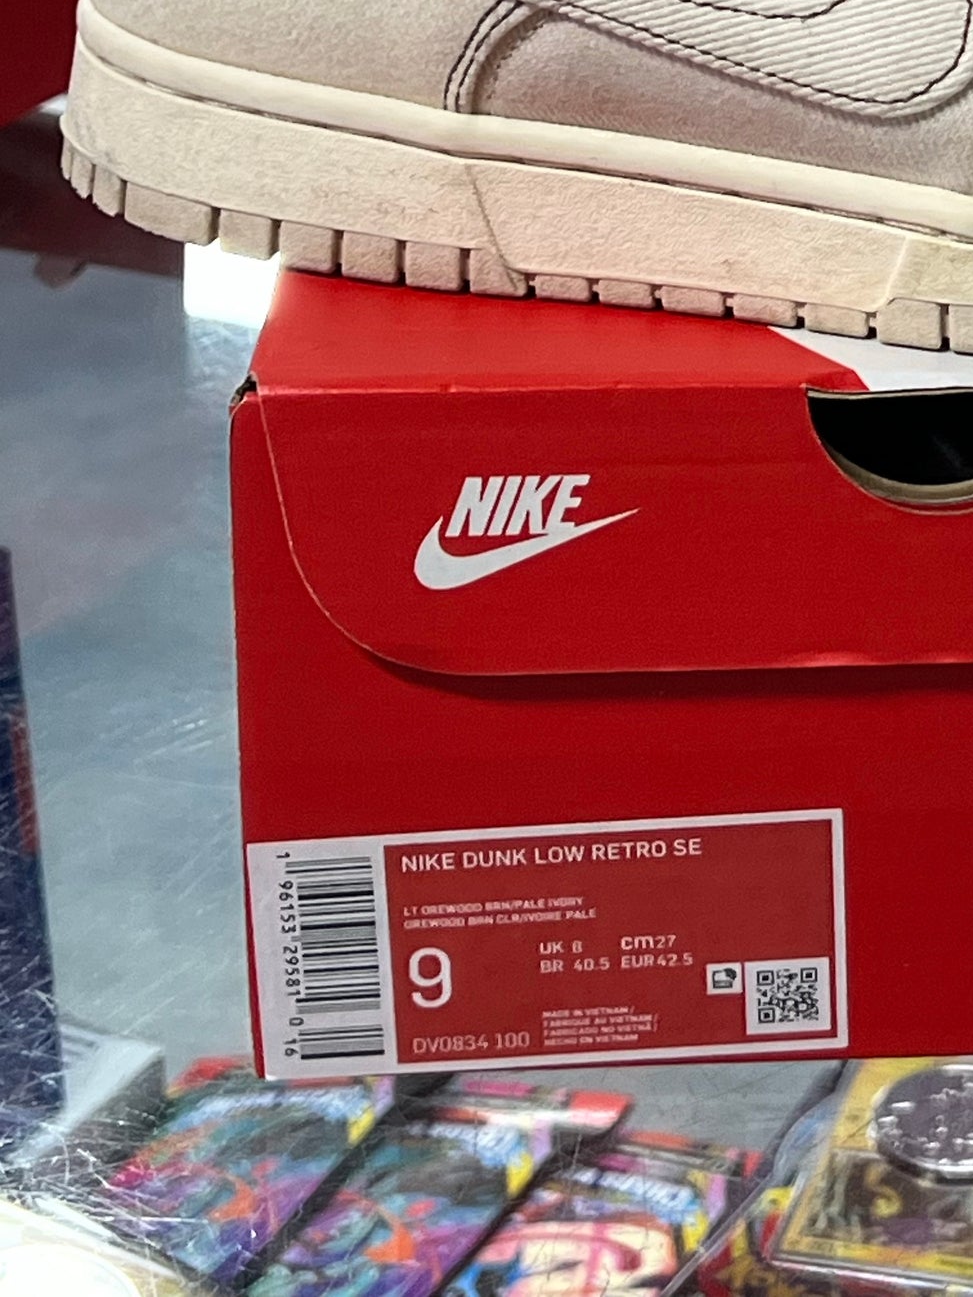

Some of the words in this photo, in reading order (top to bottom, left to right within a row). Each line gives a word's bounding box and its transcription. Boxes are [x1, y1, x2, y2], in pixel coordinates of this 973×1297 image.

[444, 473, 592, 539] NIKE
[401, 853, 455, 873] NIKE
[463, 848, 527, 870] DUNK
[534, 844, 586, 865] LOW
[591, 840, 666, 861] RETRO
[673, 838, 702, 856] SE
[279, 880, 297, 934] 96153
[539, 941, 564, 955] UK
[540, 959, 565, 974] BR
[283, 945, 302, 997] 29581
[408, 946, 454, 1009] 9
[413, 1032, 489, 1054] DV0834
[495, 1030, 531, 1049] 100
